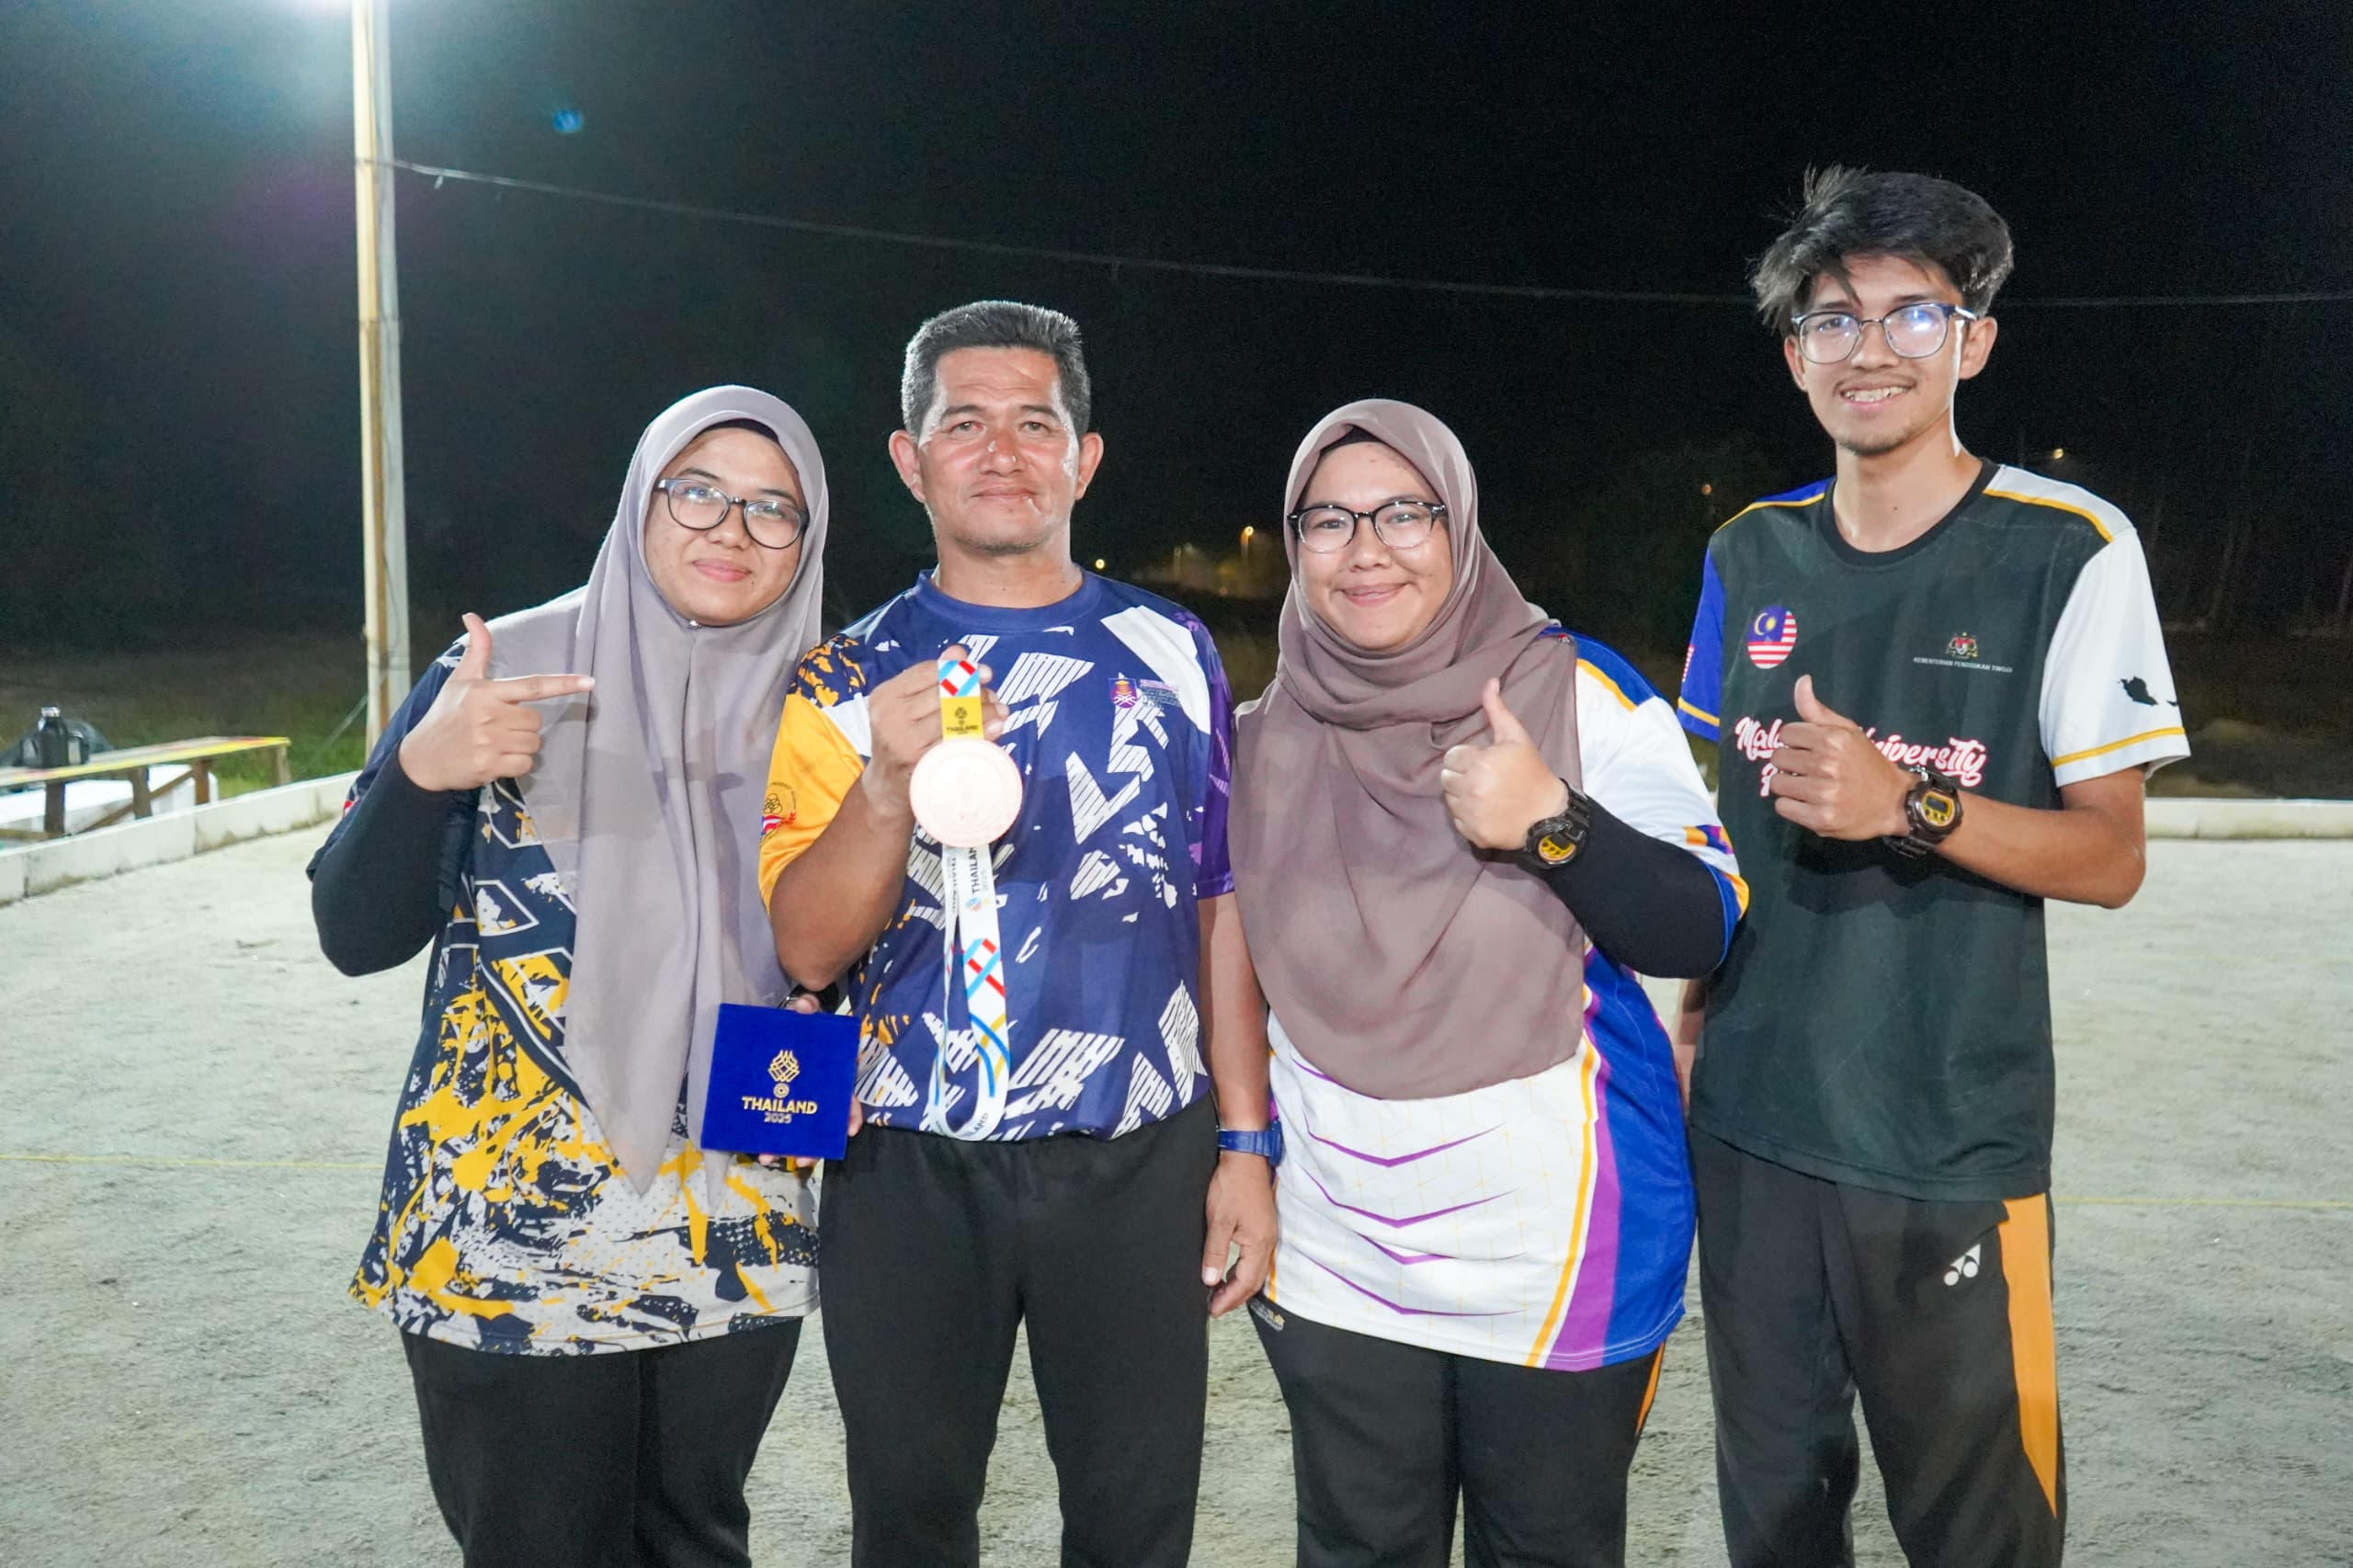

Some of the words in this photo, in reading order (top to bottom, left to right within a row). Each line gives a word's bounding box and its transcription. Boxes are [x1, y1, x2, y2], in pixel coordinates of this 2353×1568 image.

[968, 847, 981, 894] THAILAN
[742, 1096, 818, 1115] THAILAND
[764, 1111, 792, 1124] 2025
